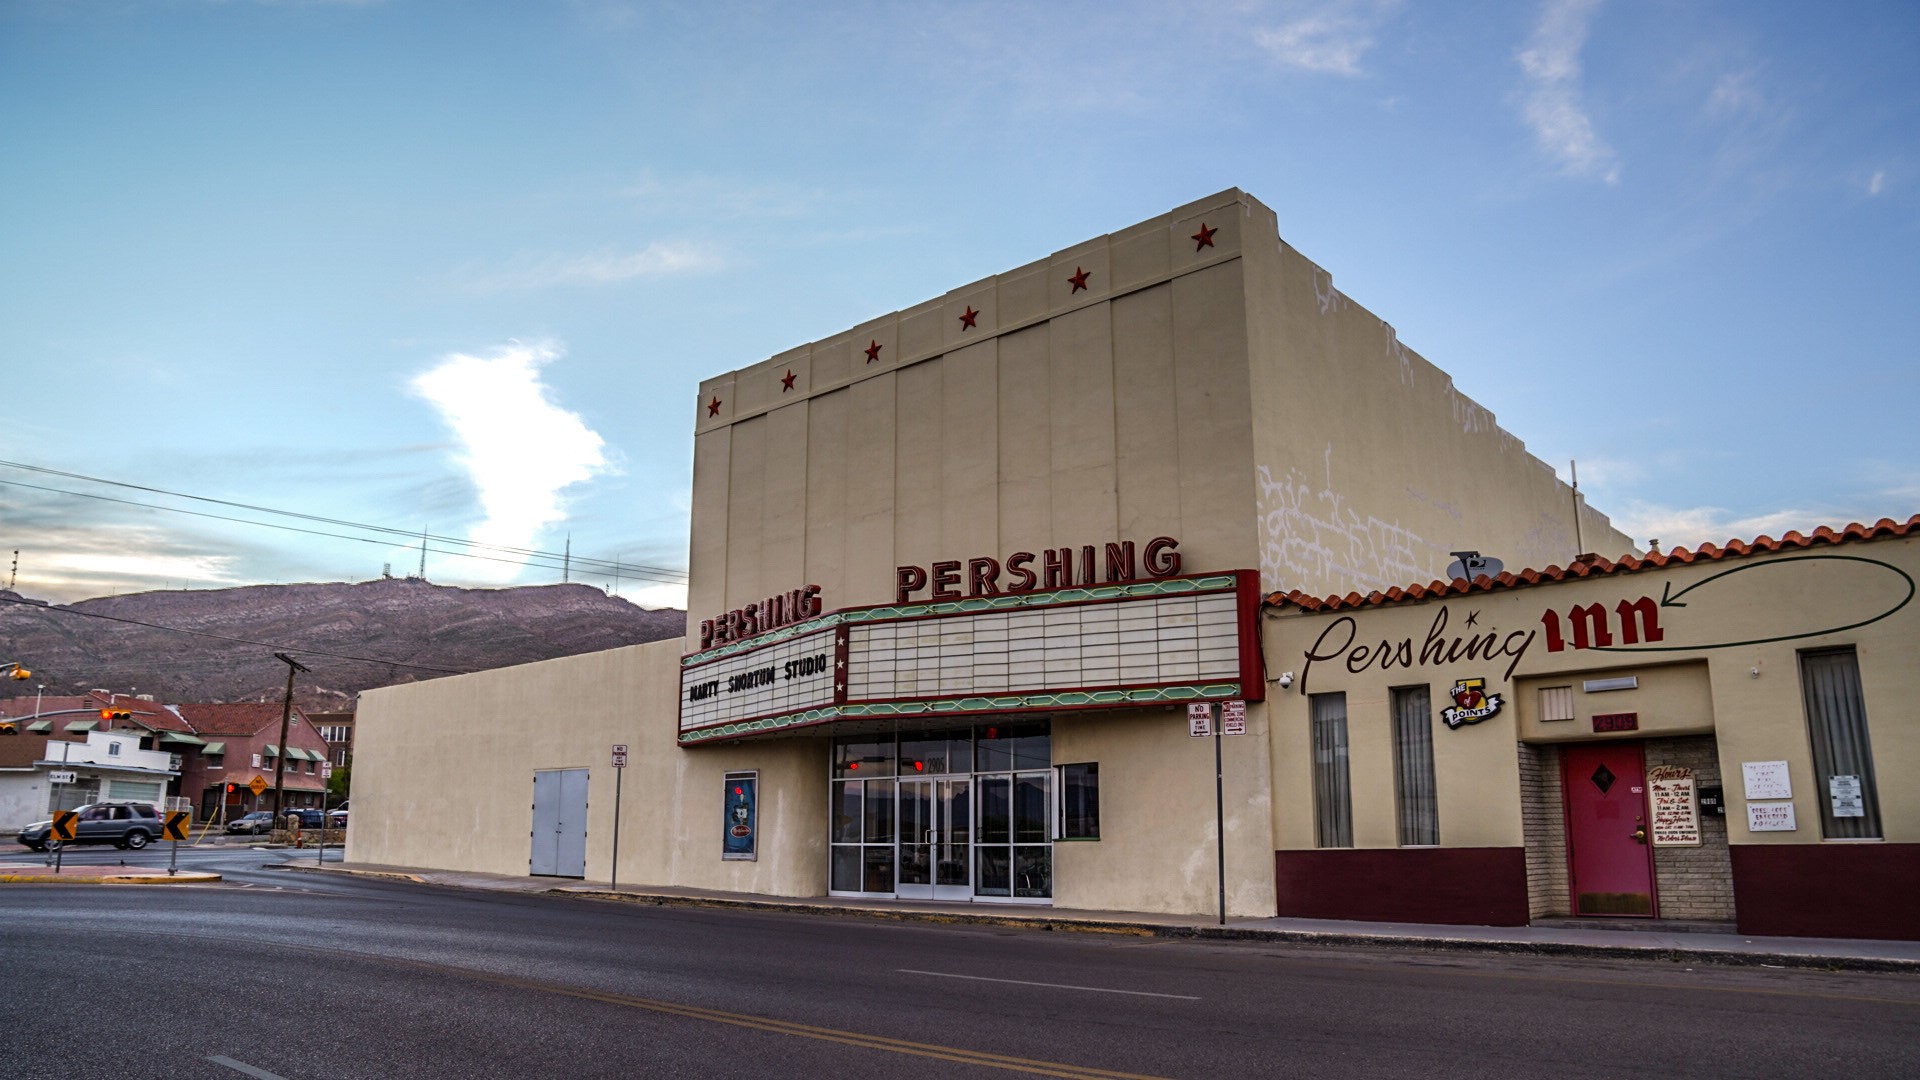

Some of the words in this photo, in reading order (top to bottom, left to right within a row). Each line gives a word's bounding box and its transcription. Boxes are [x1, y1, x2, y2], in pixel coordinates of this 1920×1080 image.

[897, 536, 1182, 602] PERSHING
[700, 584, 822, 650] PERSHING
[1300, 605, 1536, 696] Pershing
[690, 680, 719, 702] MARTY
[784, 654, 826, 680] STUDIO
[1450, 684, 1466, 697] THE
[1464, 697, 1471, 706] of
[1452, 706, 1491, 721] POINTS
[928, 757, 944, 773] 2905
[1655, 816, 1673, 824] Happy
